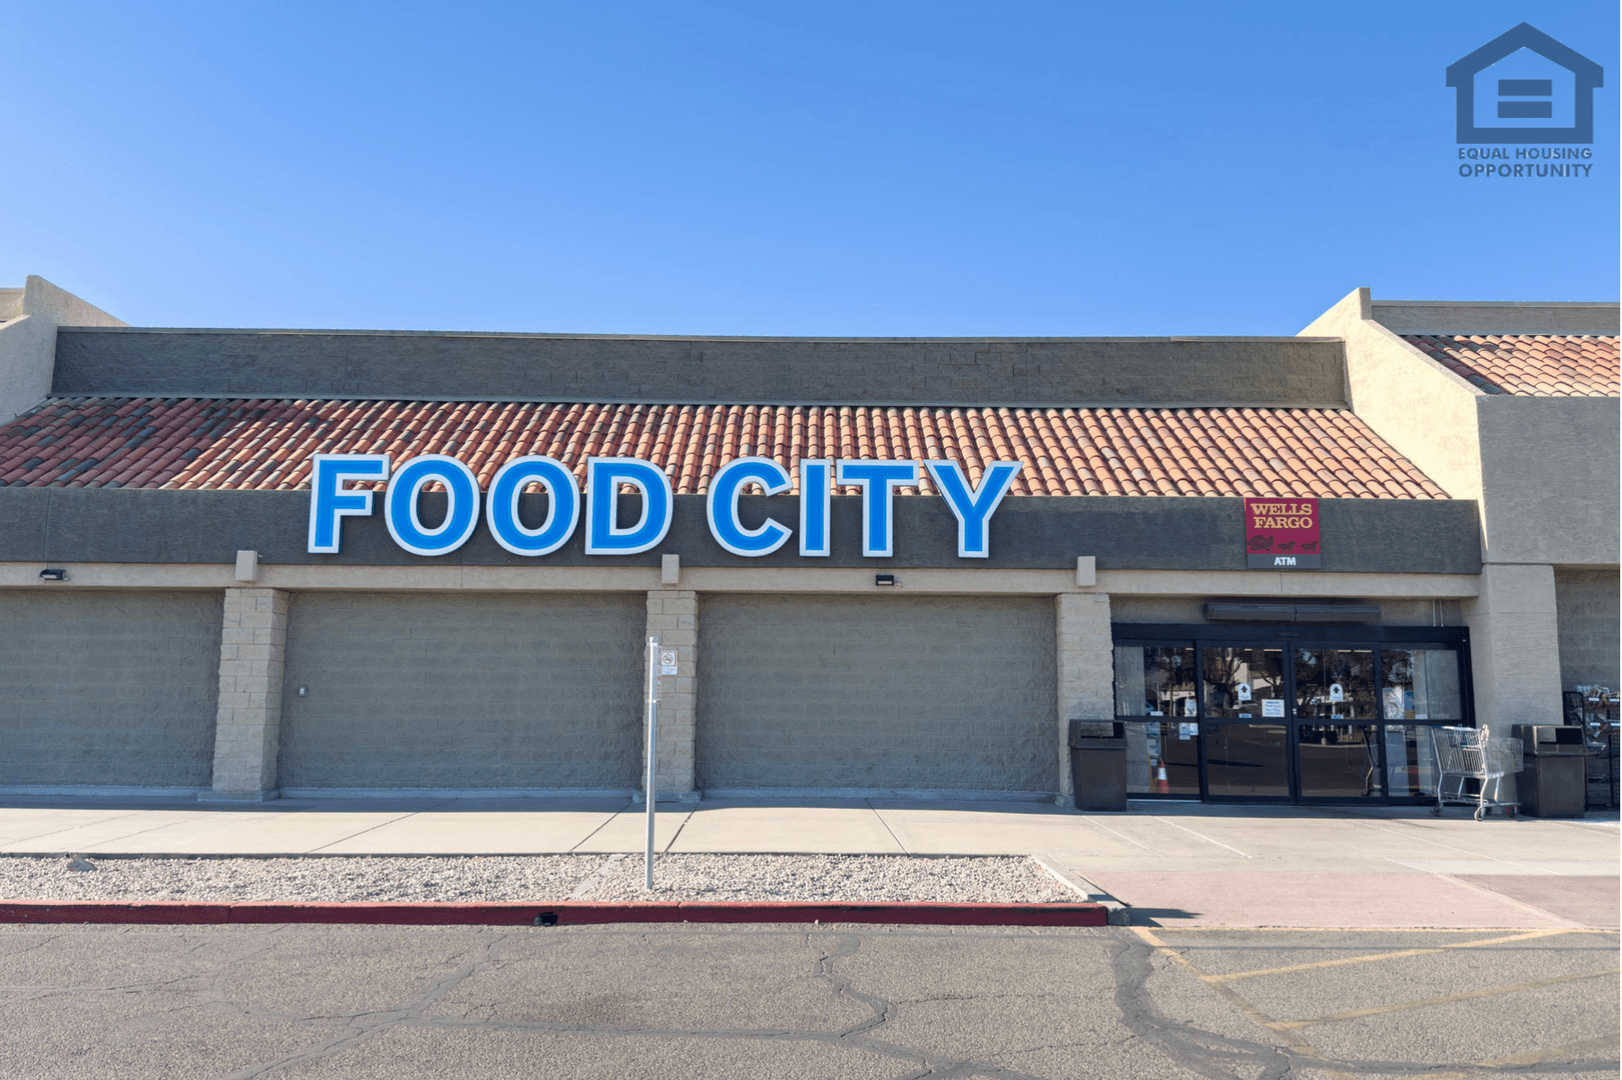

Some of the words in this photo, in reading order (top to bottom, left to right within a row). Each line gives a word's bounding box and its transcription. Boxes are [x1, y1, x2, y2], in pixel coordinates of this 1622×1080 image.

[307, 454, 674, 556] FOOD
[706, 456, 1024, 558] CITY
[1250, 503, 1313, 515] WELLS
[1253, 516, 1313, 529] FARGO
[1274, 556, 1297, 566] ATM
